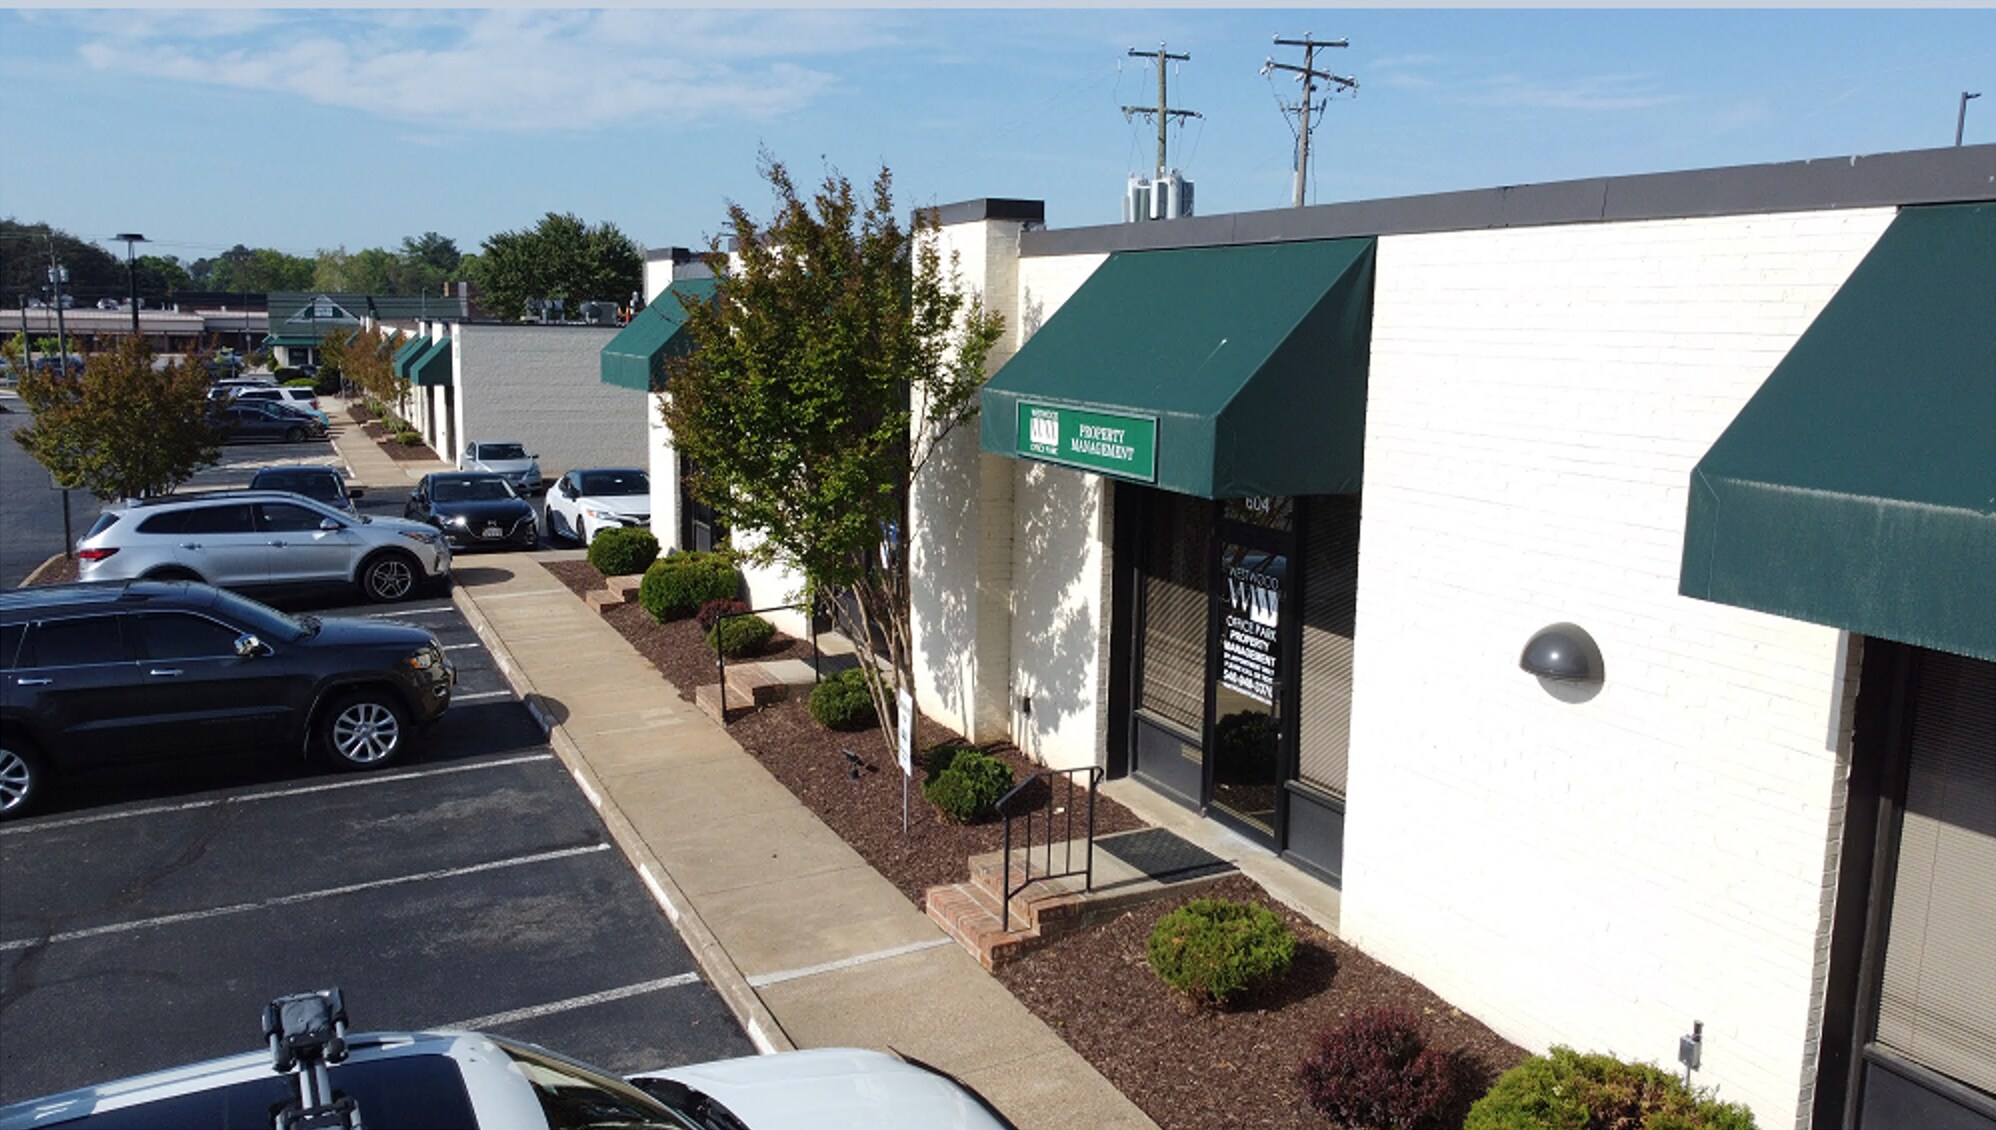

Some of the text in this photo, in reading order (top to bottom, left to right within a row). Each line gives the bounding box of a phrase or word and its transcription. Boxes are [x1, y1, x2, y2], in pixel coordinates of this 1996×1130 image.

[1079, 424, 1126, 443] PROPERTY
[1071, 438, 1135, 461] MANAGEMENT
[1245, 495, 1270, 513] 604
[1226, 615, 1277, 643] OFFICE PARK
[1229, 629, 1270, 652] PROPERTY
[1223, 640, 1277, 667] MANAGEMENT
